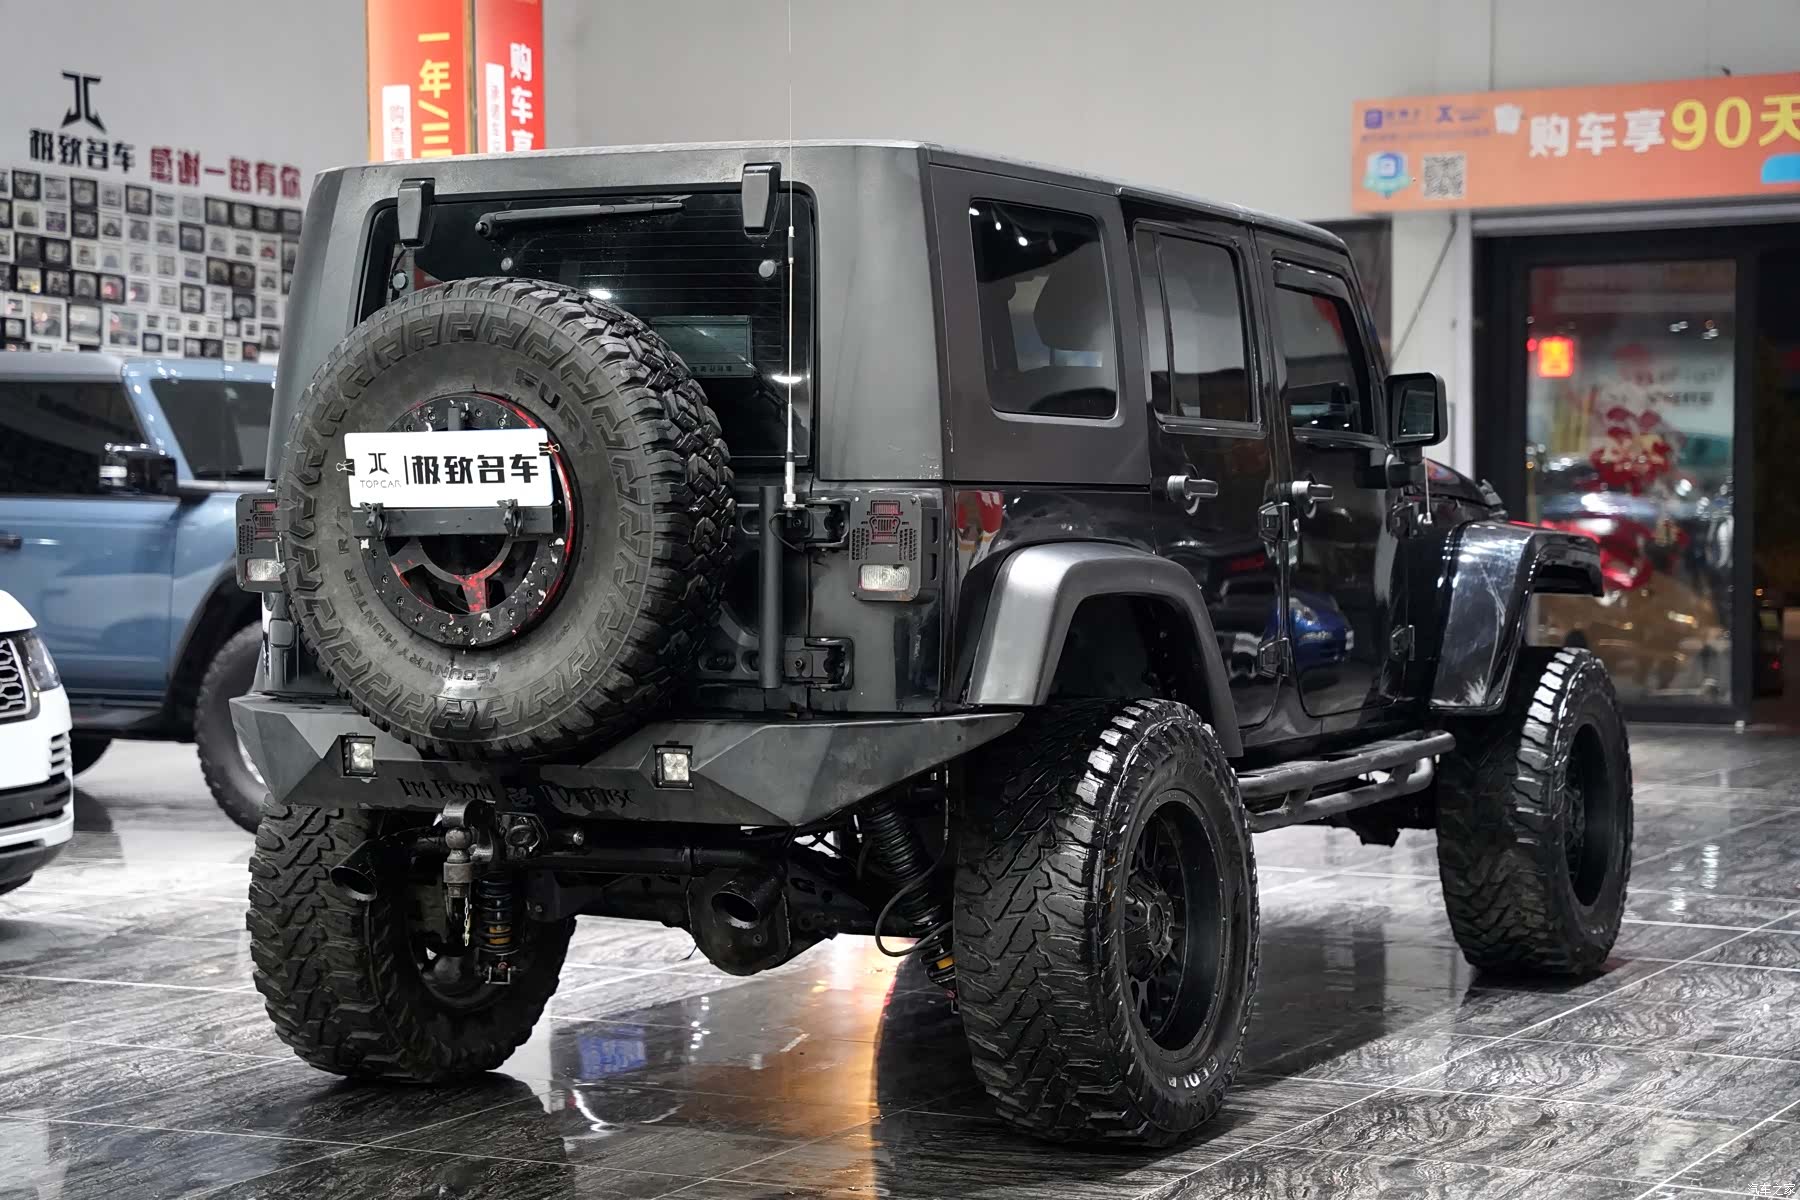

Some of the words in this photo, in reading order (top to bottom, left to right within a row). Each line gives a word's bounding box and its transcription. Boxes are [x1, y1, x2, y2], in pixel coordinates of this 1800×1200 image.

[29, 128, 134, 173] 极致名车
[1528, 94, 1800, 157] 购车享90天
[151, 146, 300, 198] 感谢一路有你
[514, 367, 595, 453] FURY
[411, 453, 539, 484] 极致名车
